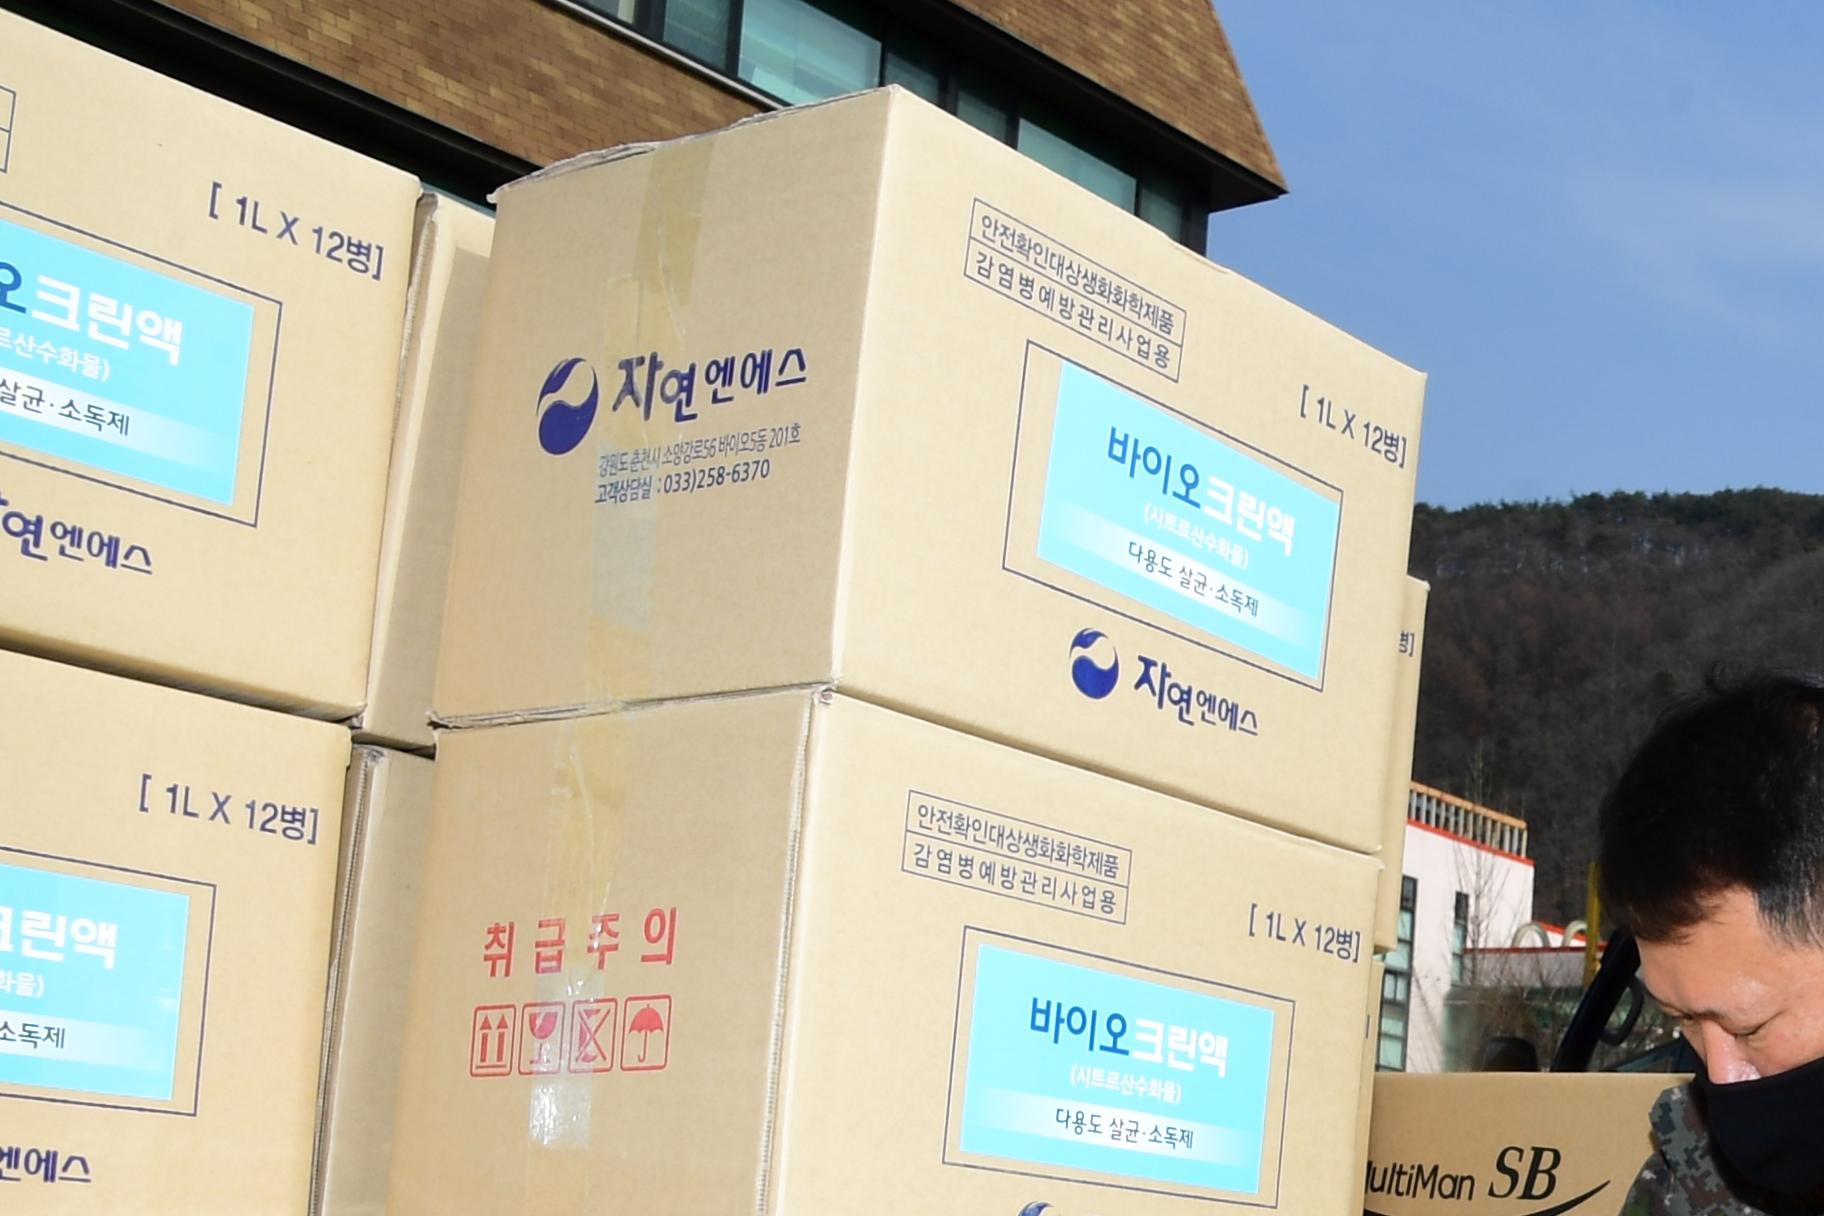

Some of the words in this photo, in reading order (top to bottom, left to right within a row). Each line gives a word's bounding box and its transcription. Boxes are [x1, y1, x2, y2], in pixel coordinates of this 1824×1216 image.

[769, 422, 801, 450] 201호
[1107, 426, 1297, 557] 바이오크린액
[0, 492, 153, 576] 연엔에스
[1128, 540, 1174, 579] 다용도
[1133, 655, 1260, 737] 자연엔에스
[483, 906, 678, 978] 취급주의
[1030, 996, 1230, 1079] 바이오크린액
[1055, 1107, 1103, 1138] 다용도
[1487, 1145, 1562, 1201] SB
